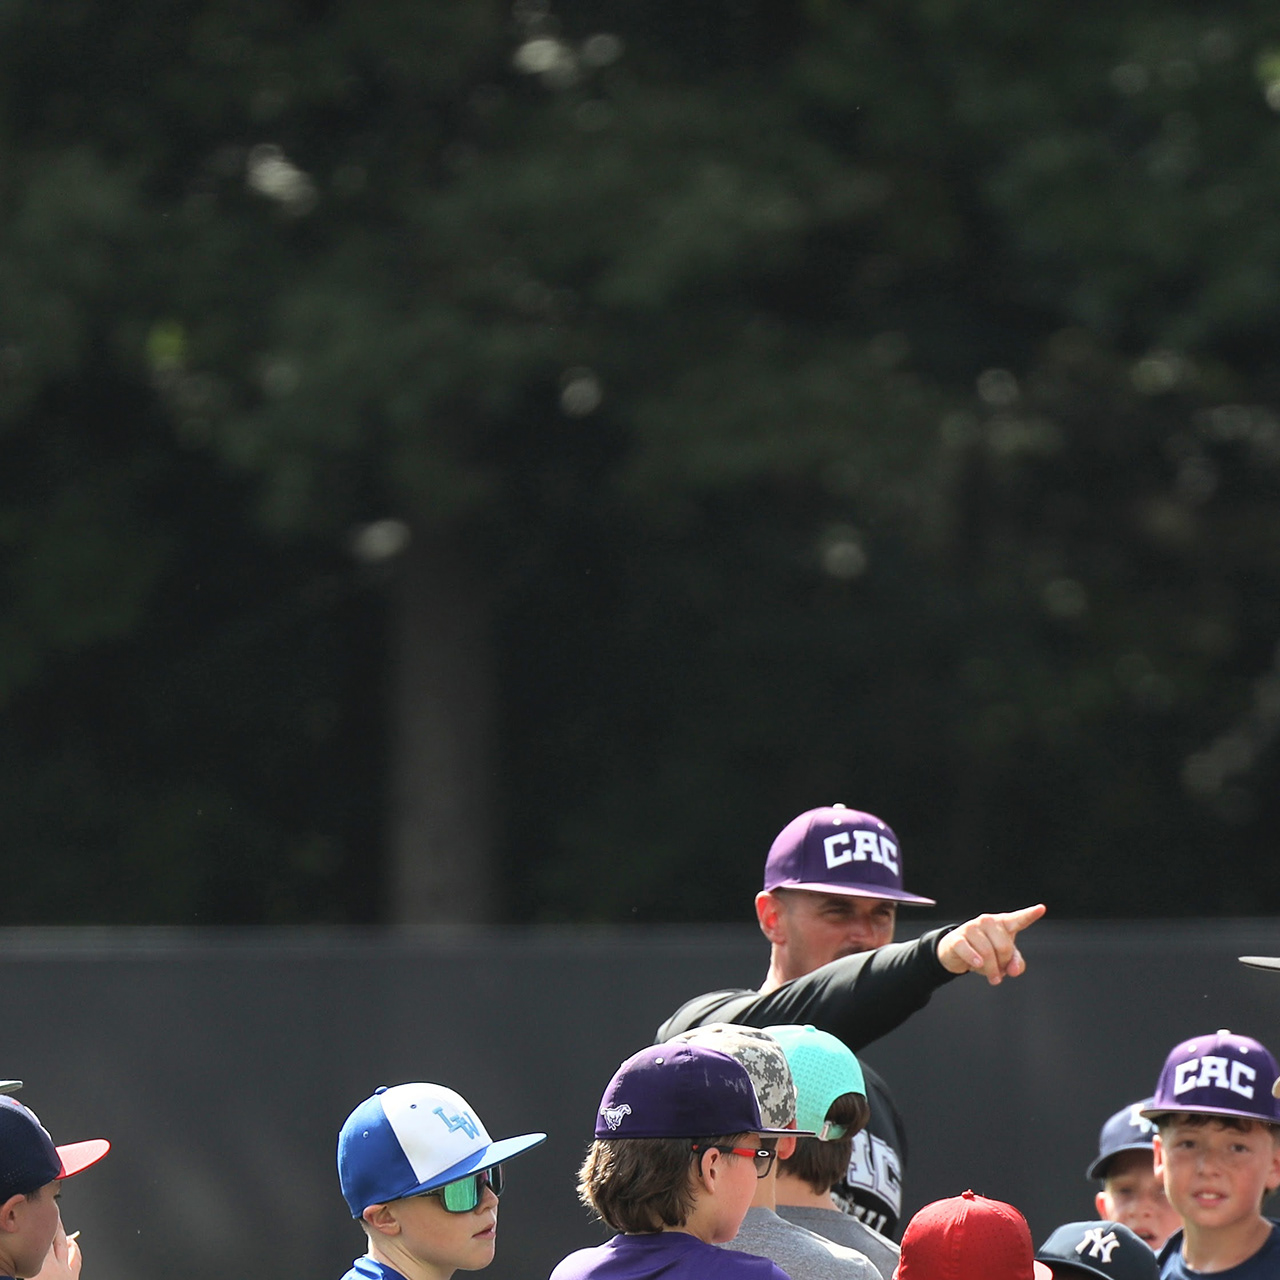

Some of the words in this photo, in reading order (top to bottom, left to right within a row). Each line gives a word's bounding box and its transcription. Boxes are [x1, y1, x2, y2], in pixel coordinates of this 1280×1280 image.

[823, 829, 899, 877] CAC
[1173, 1055, 1257, 1101] CAC
[1075, 1227, 1121, 1264] NY
